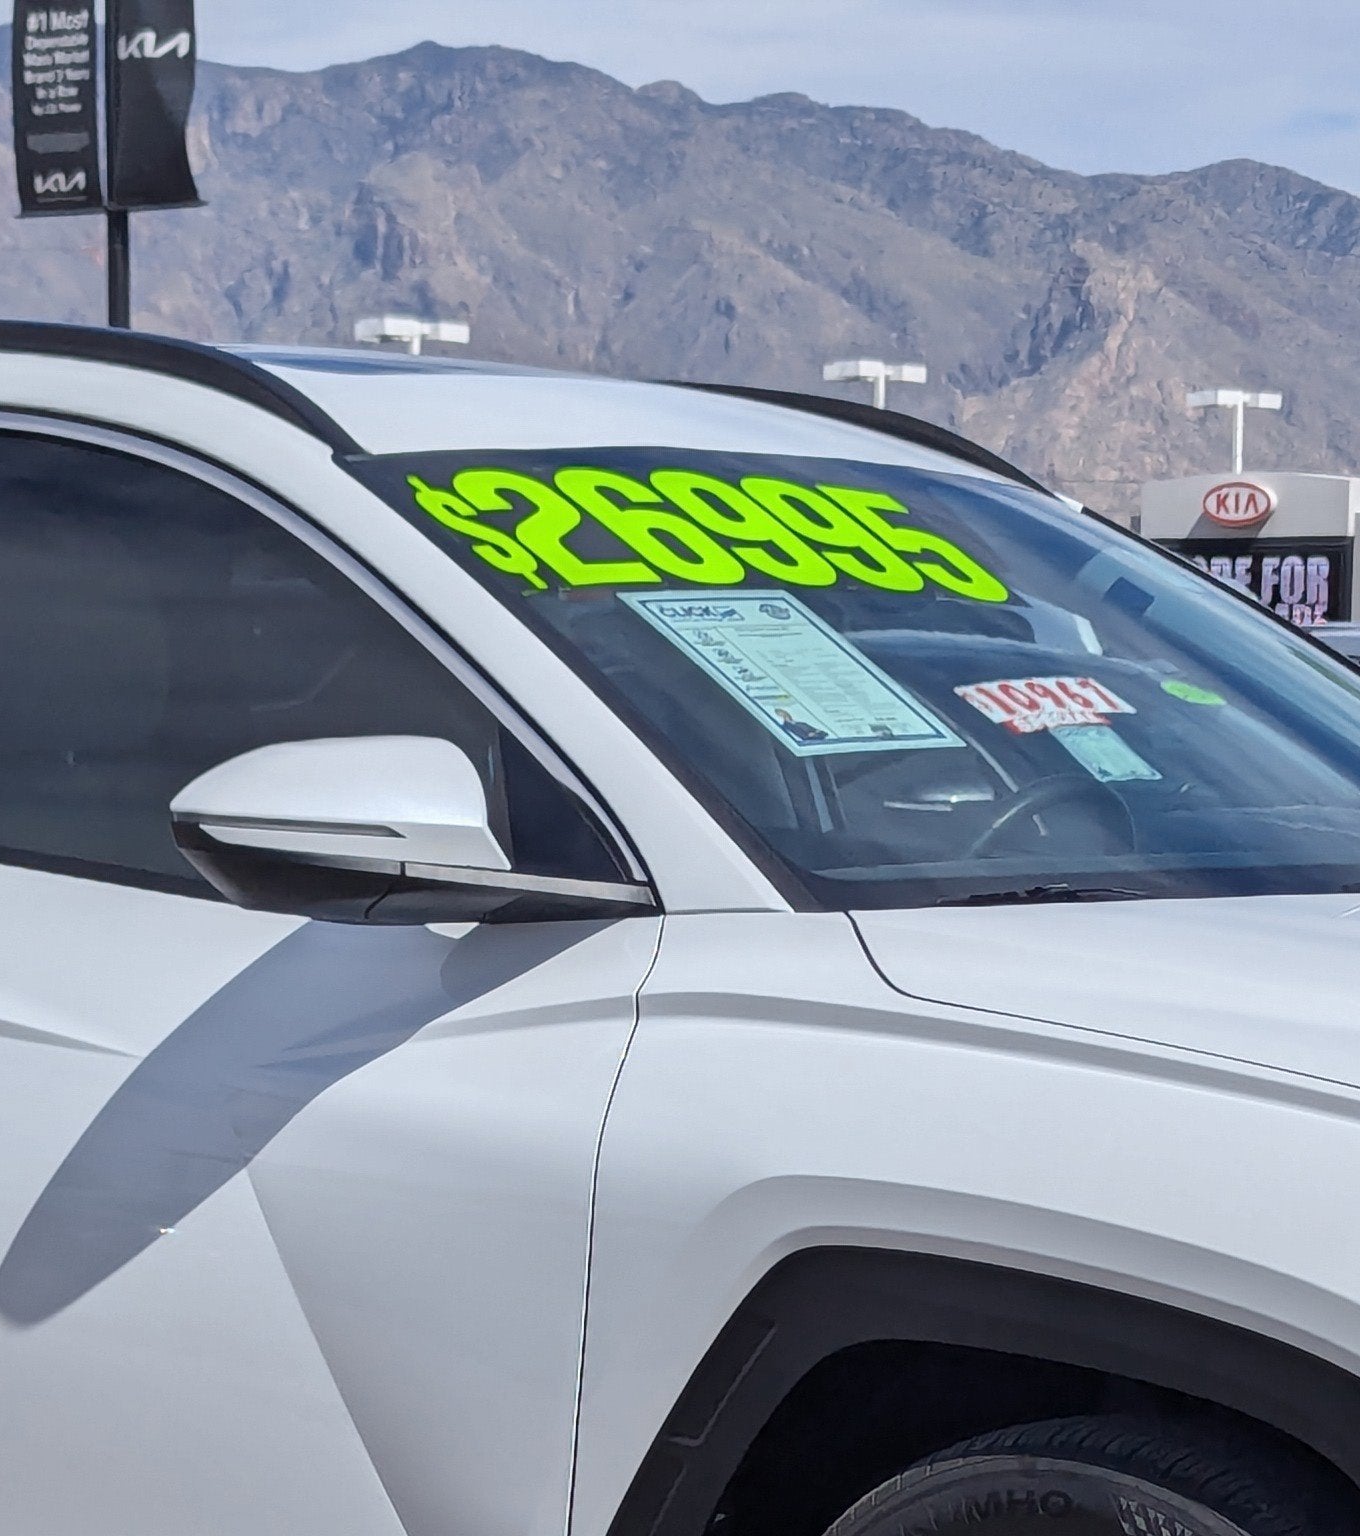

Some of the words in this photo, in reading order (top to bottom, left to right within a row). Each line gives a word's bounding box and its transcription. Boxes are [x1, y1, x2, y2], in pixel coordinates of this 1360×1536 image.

[1215, 491, 1260, 516] KIA
[406, 466, 1009, 603] $26995
[1260, 555, 1330, 607] FOR
